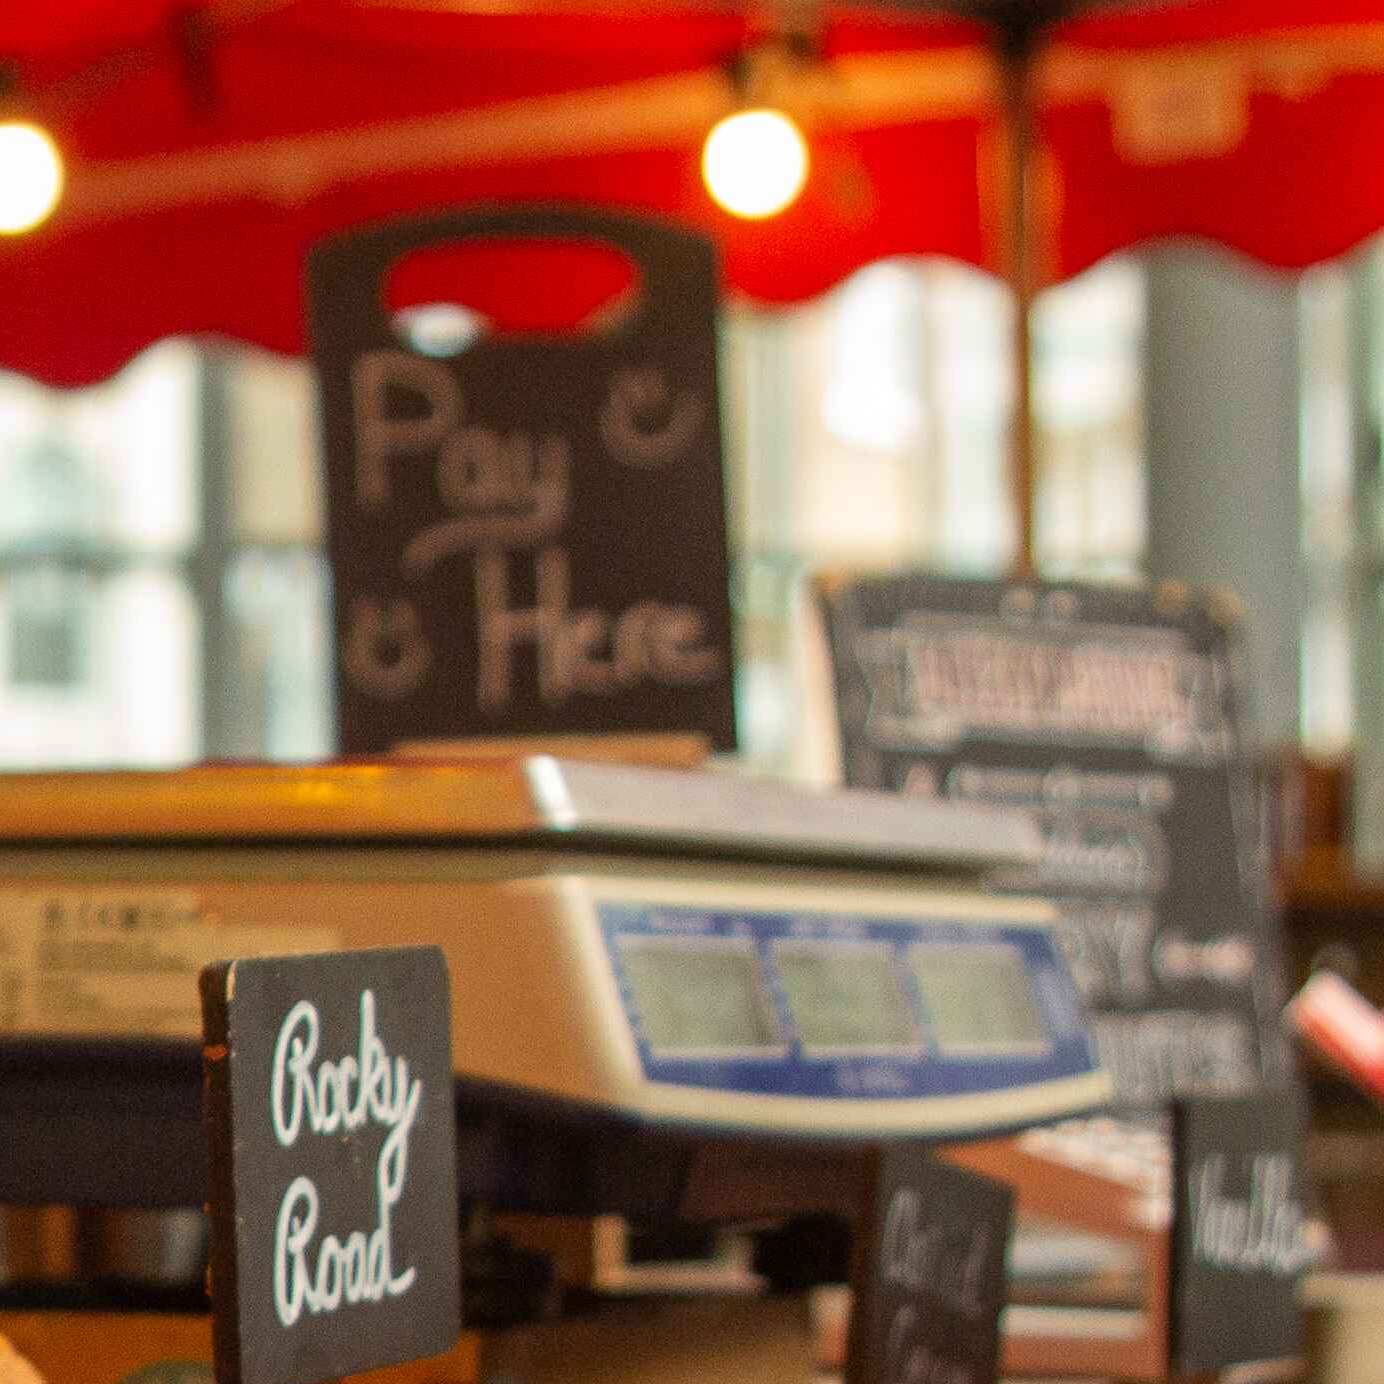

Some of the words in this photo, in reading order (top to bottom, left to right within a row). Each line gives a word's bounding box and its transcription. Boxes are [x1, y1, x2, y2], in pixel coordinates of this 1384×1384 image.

[353, 348, 568, 574] Pay
[473, 546, 721, 716] Here
[270, 989, 422, 1202] Rocky
[272, 1176, 416, 1328] Road
